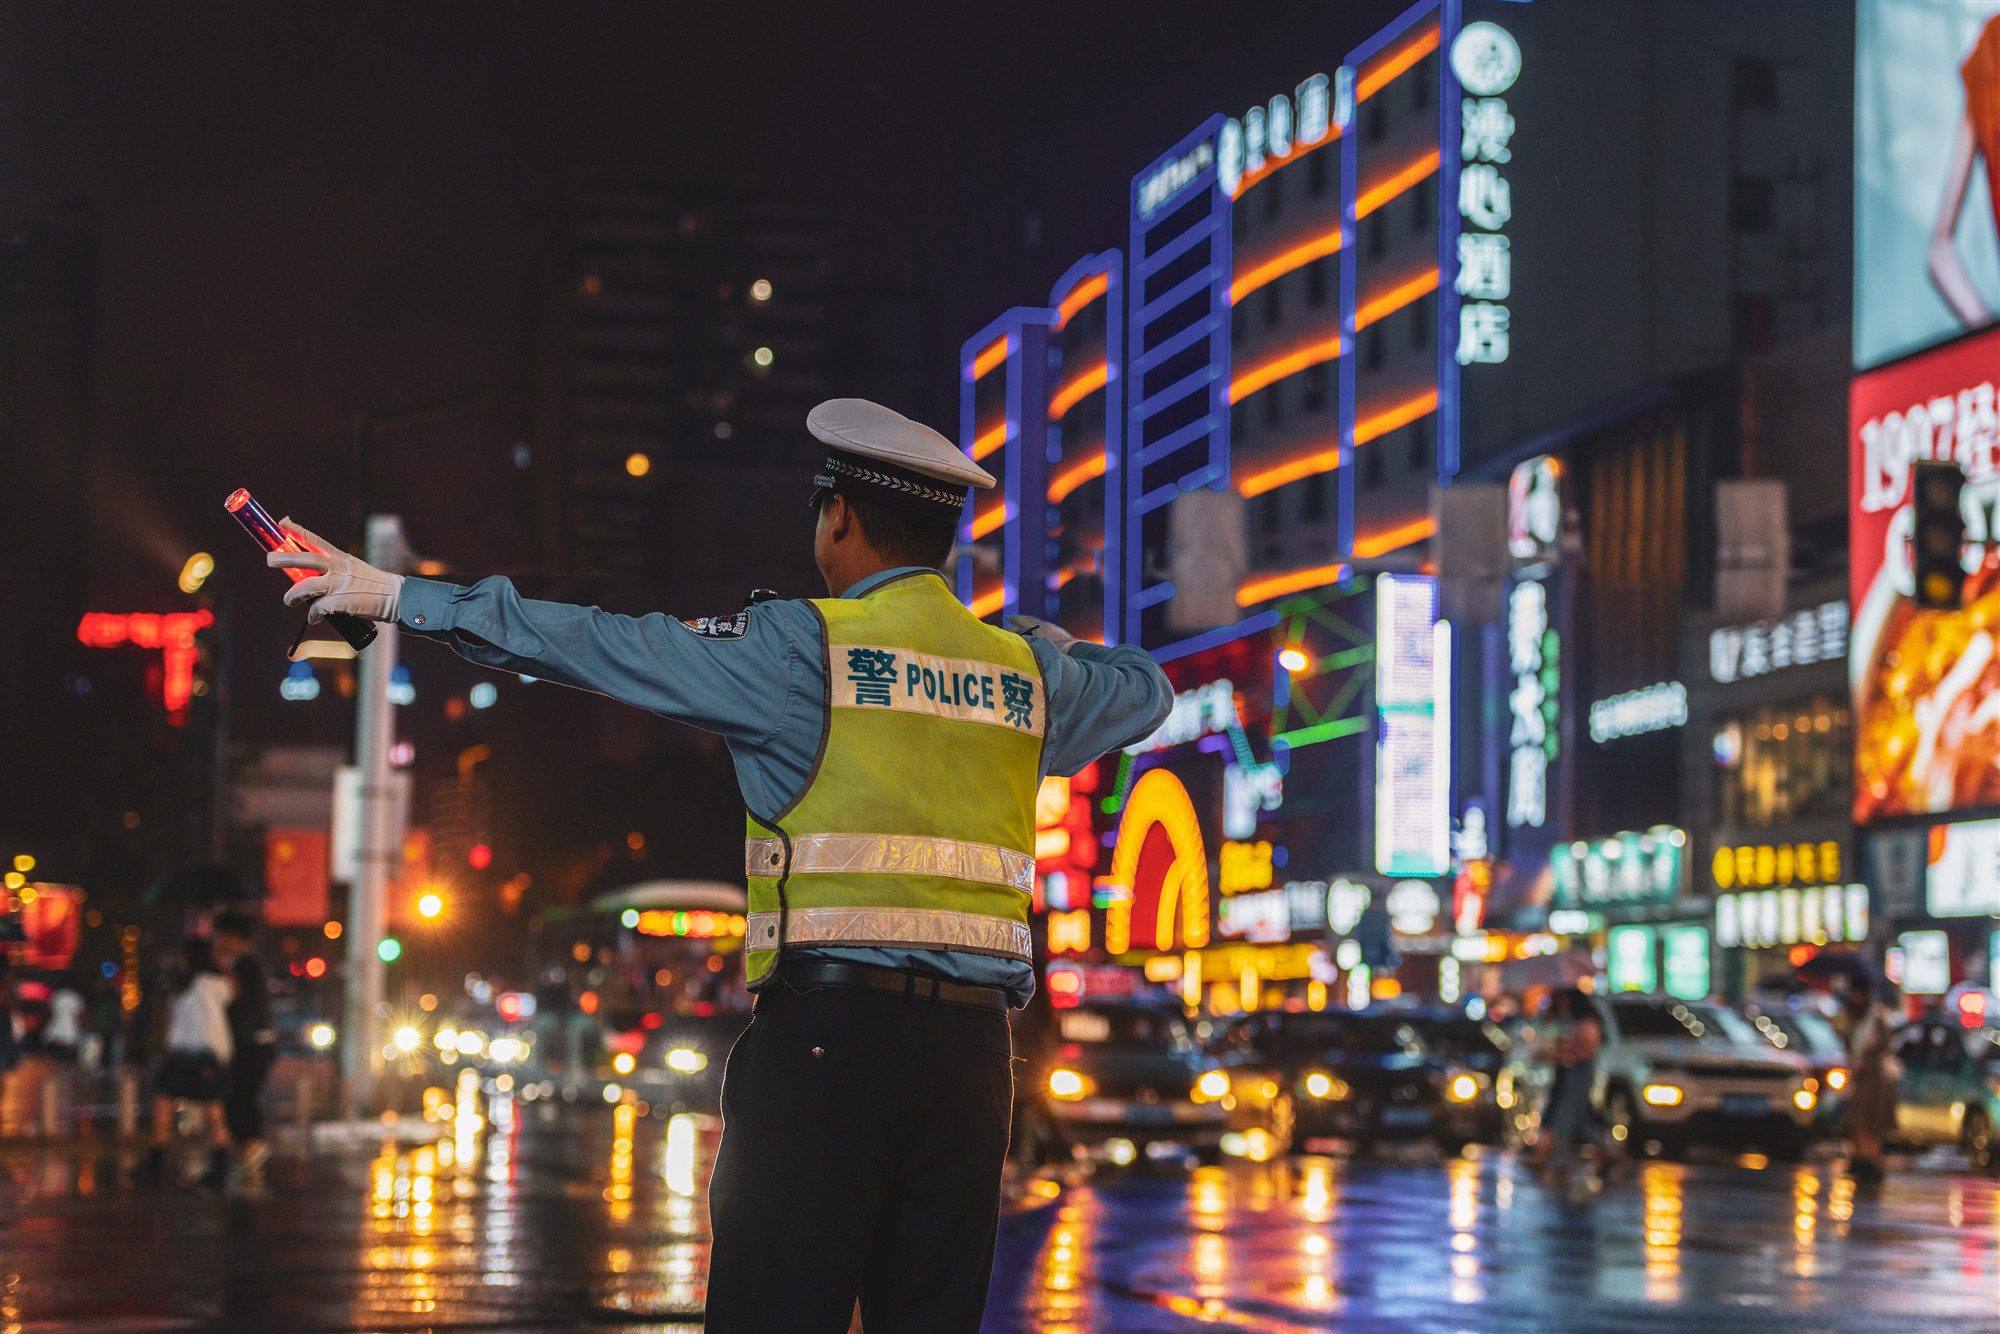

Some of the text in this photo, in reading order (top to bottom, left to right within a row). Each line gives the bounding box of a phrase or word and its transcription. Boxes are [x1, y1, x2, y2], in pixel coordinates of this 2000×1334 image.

[847, 648, 1035, 730] 警 POLICE 察
